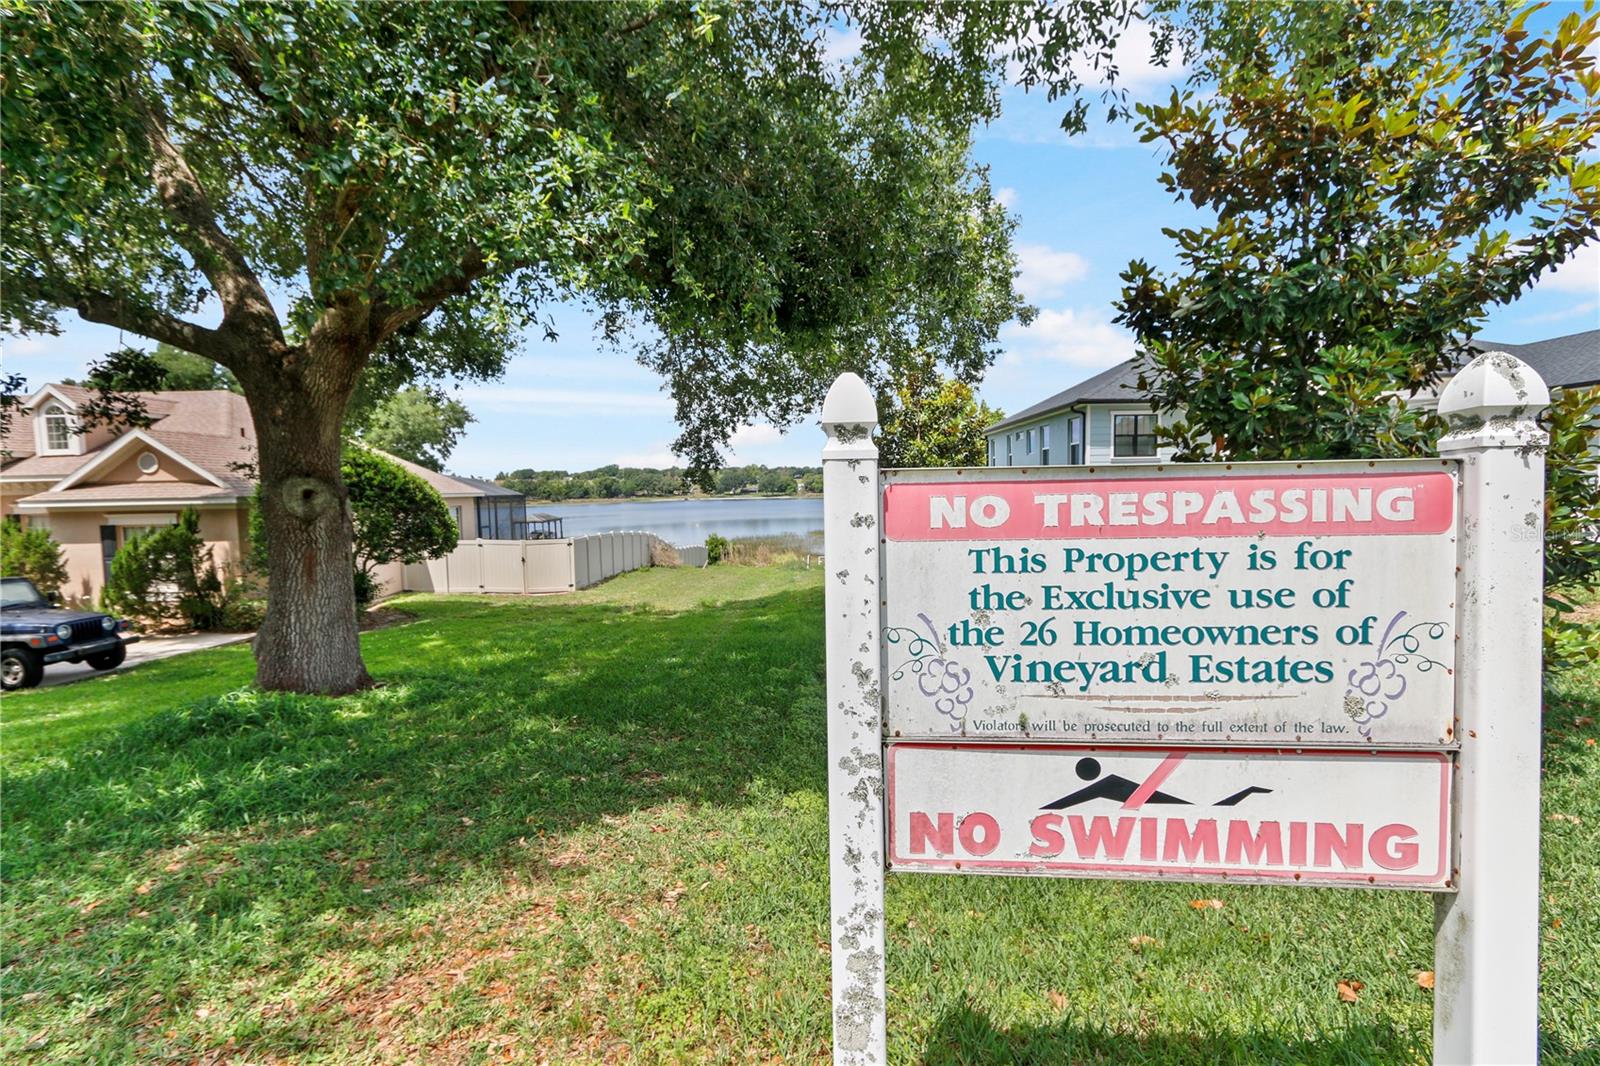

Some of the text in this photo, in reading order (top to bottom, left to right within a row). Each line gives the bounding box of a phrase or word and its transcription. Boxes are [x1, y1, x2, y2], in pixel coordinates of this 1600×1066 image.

[930, 487, 1415, 529] NO TRESPASSING
[968, 541, 1353, 581] This Property is for
[968, 579, 1355, 611] the Exclusive use of
[948, 616, 1378, 647] the 26 Homeowners of
[984, 651, 1335, 692] Vineyard Estates
[973, 719, 1350, 736] Violators will be prosecuted to the full extent of the law.
[909, 812, 1420, 870] NO SWIMMING
